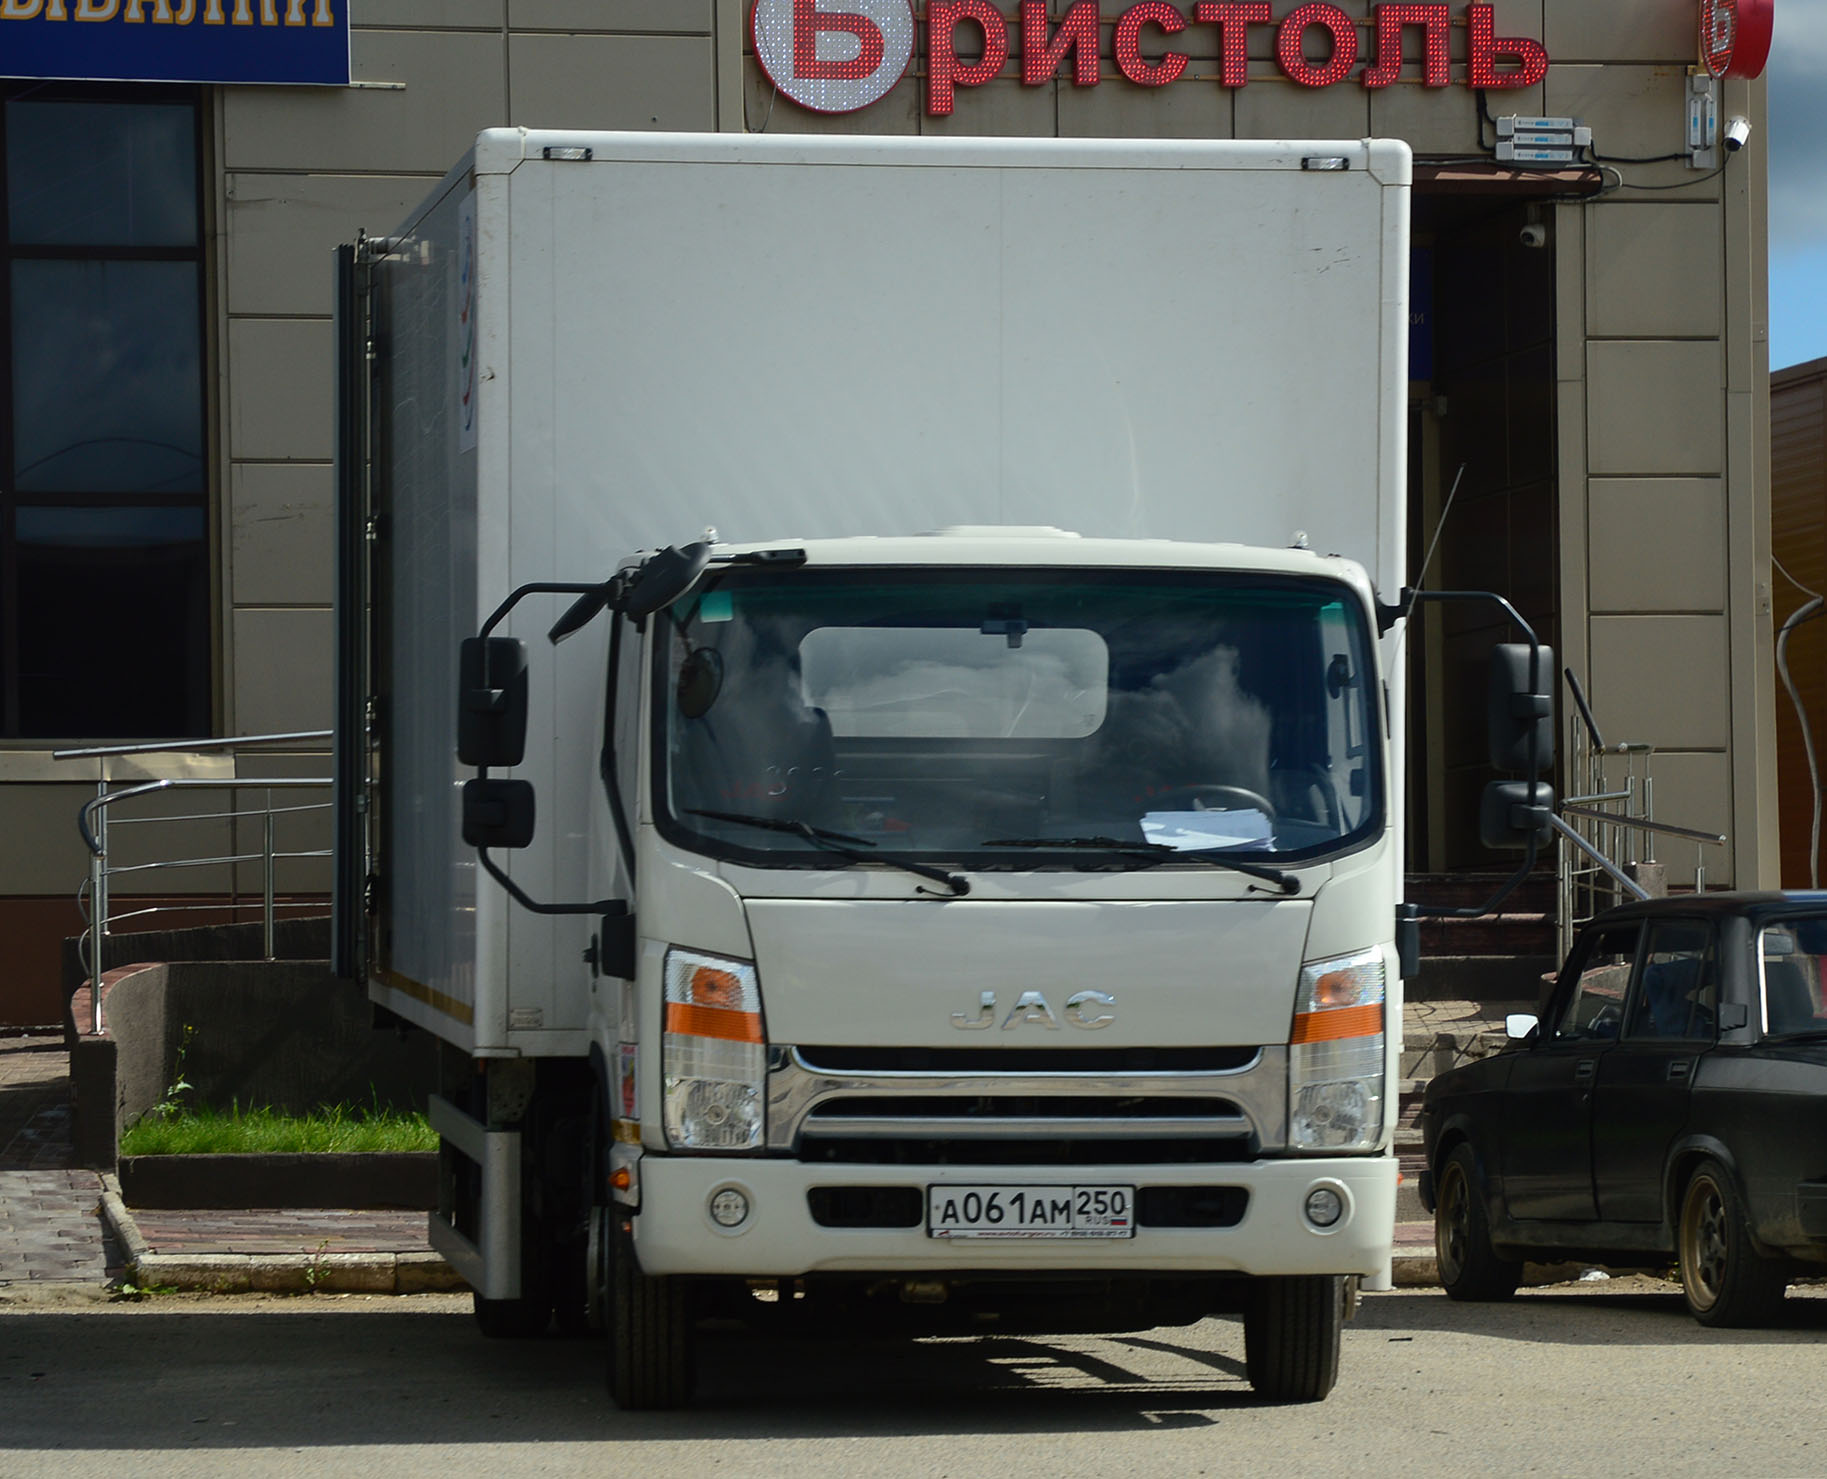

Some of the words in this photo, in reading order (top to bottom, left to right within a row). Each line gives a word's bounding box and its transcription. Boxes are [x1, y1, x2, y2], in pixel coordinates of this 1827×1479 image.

[951, 990, 1116, 1030] JAC
[1077, 1191, 1125, 1215] 250
[1085, 1215, 1110, 1226] RUS
